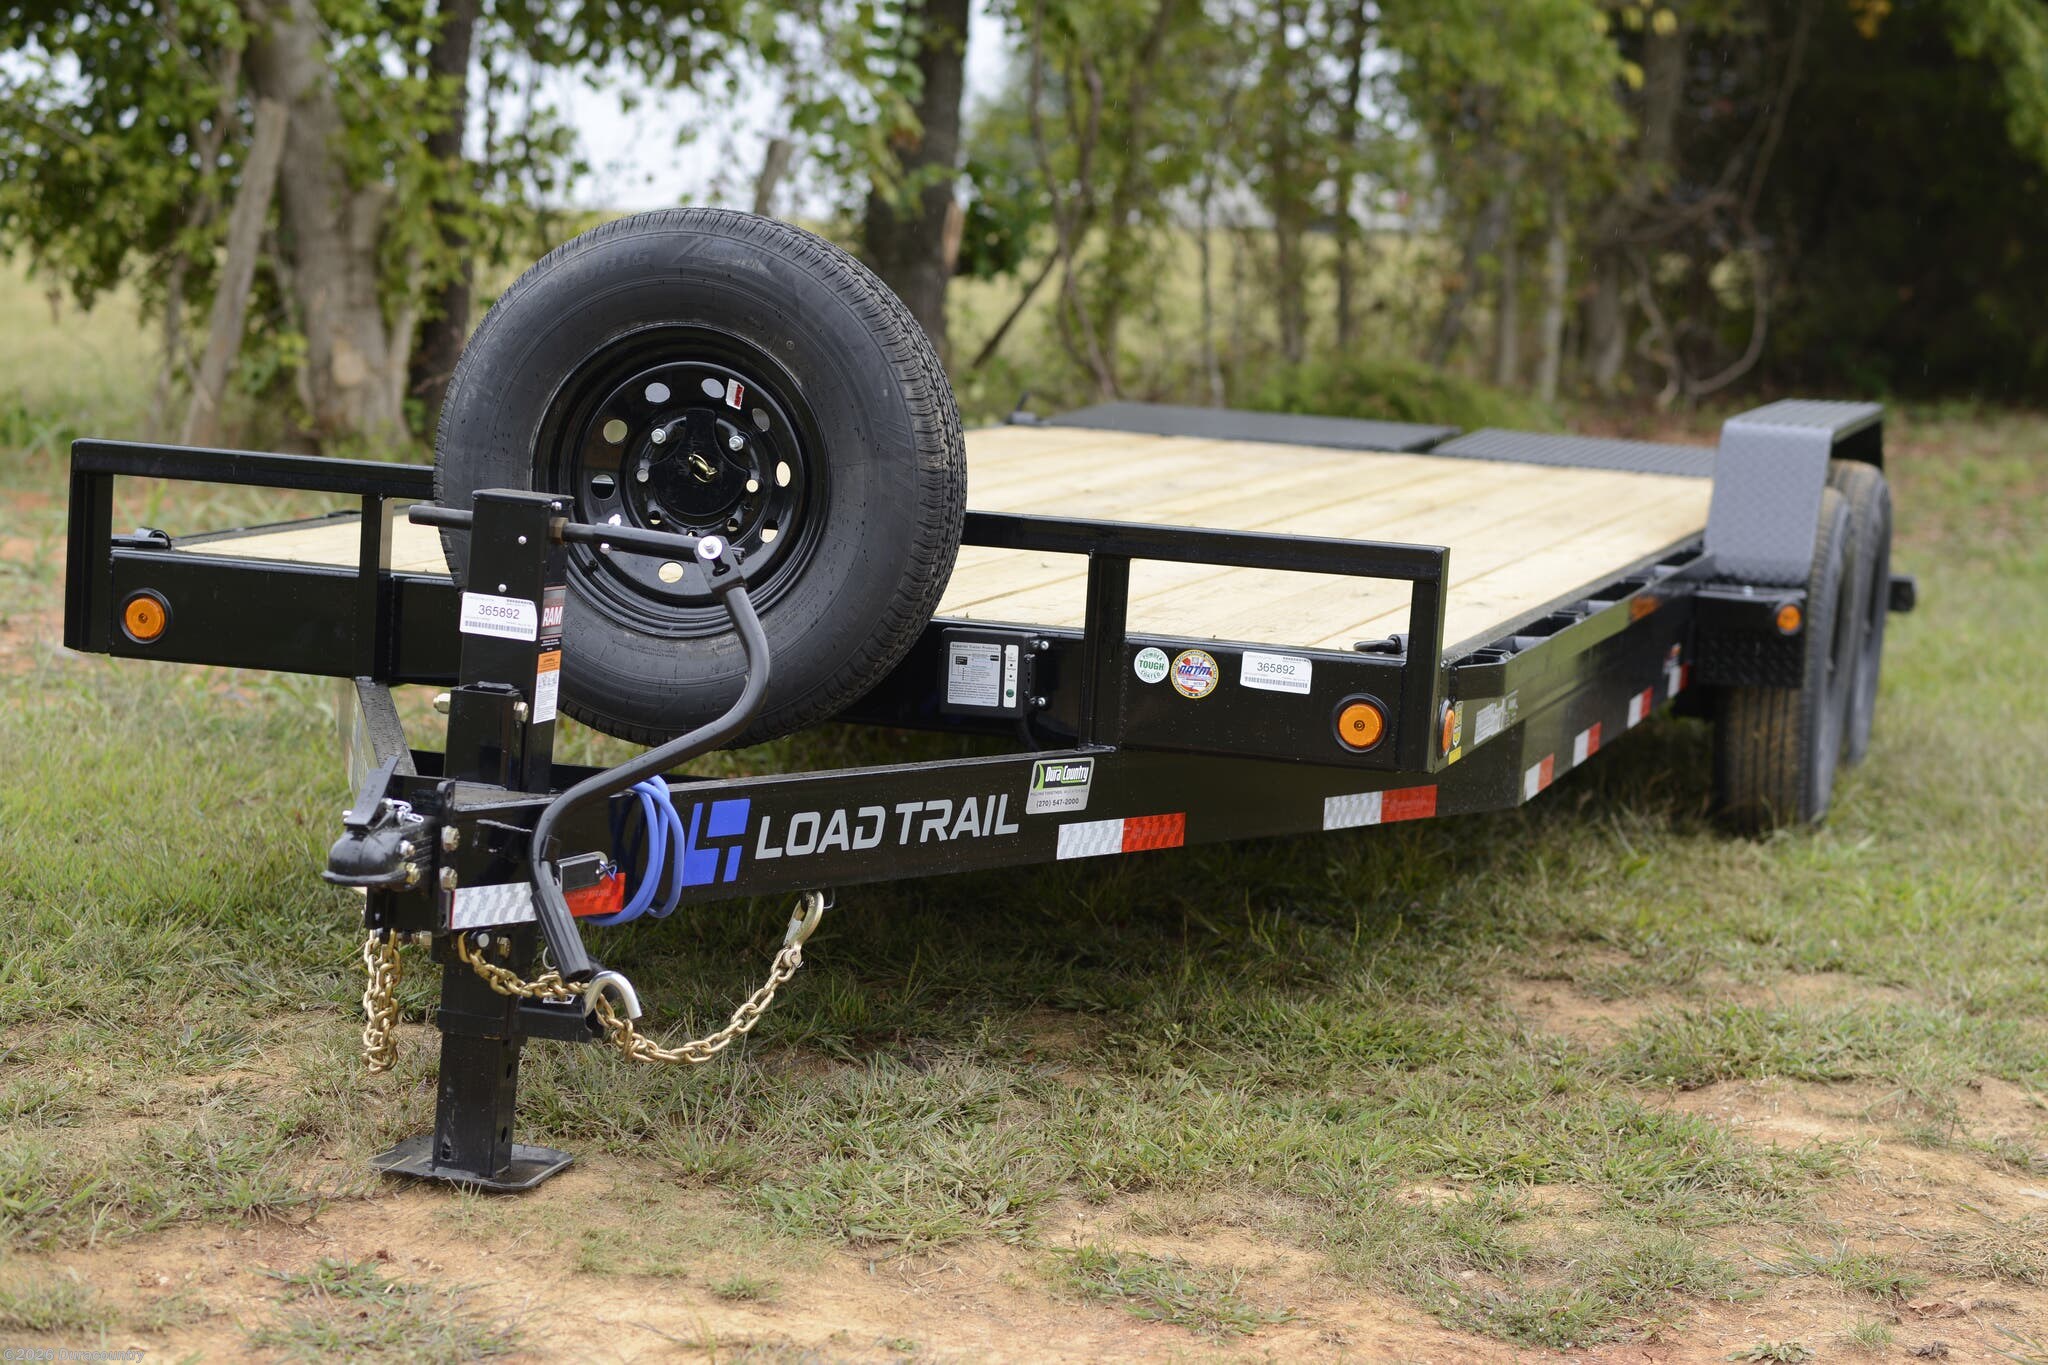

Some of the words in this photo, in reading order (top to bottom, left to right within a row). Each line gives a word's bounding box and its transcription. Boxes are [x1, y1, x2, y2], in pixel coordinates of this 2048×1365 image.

[478, 604, 521, 620] 365892
[542, 606, 563, 627] RAM
[1139, 660, 1164, 671] TOUGH
[1256, 662, 1296, 676] 365892
[1045, 766, 1062, 782] Dura
[1062, 764, 1089, 783] Country
[1036, 799, 1051, 808] (270)
[754, 805, 886, 861] LOAD
[894, 793, 1020, 846] TRAIL
